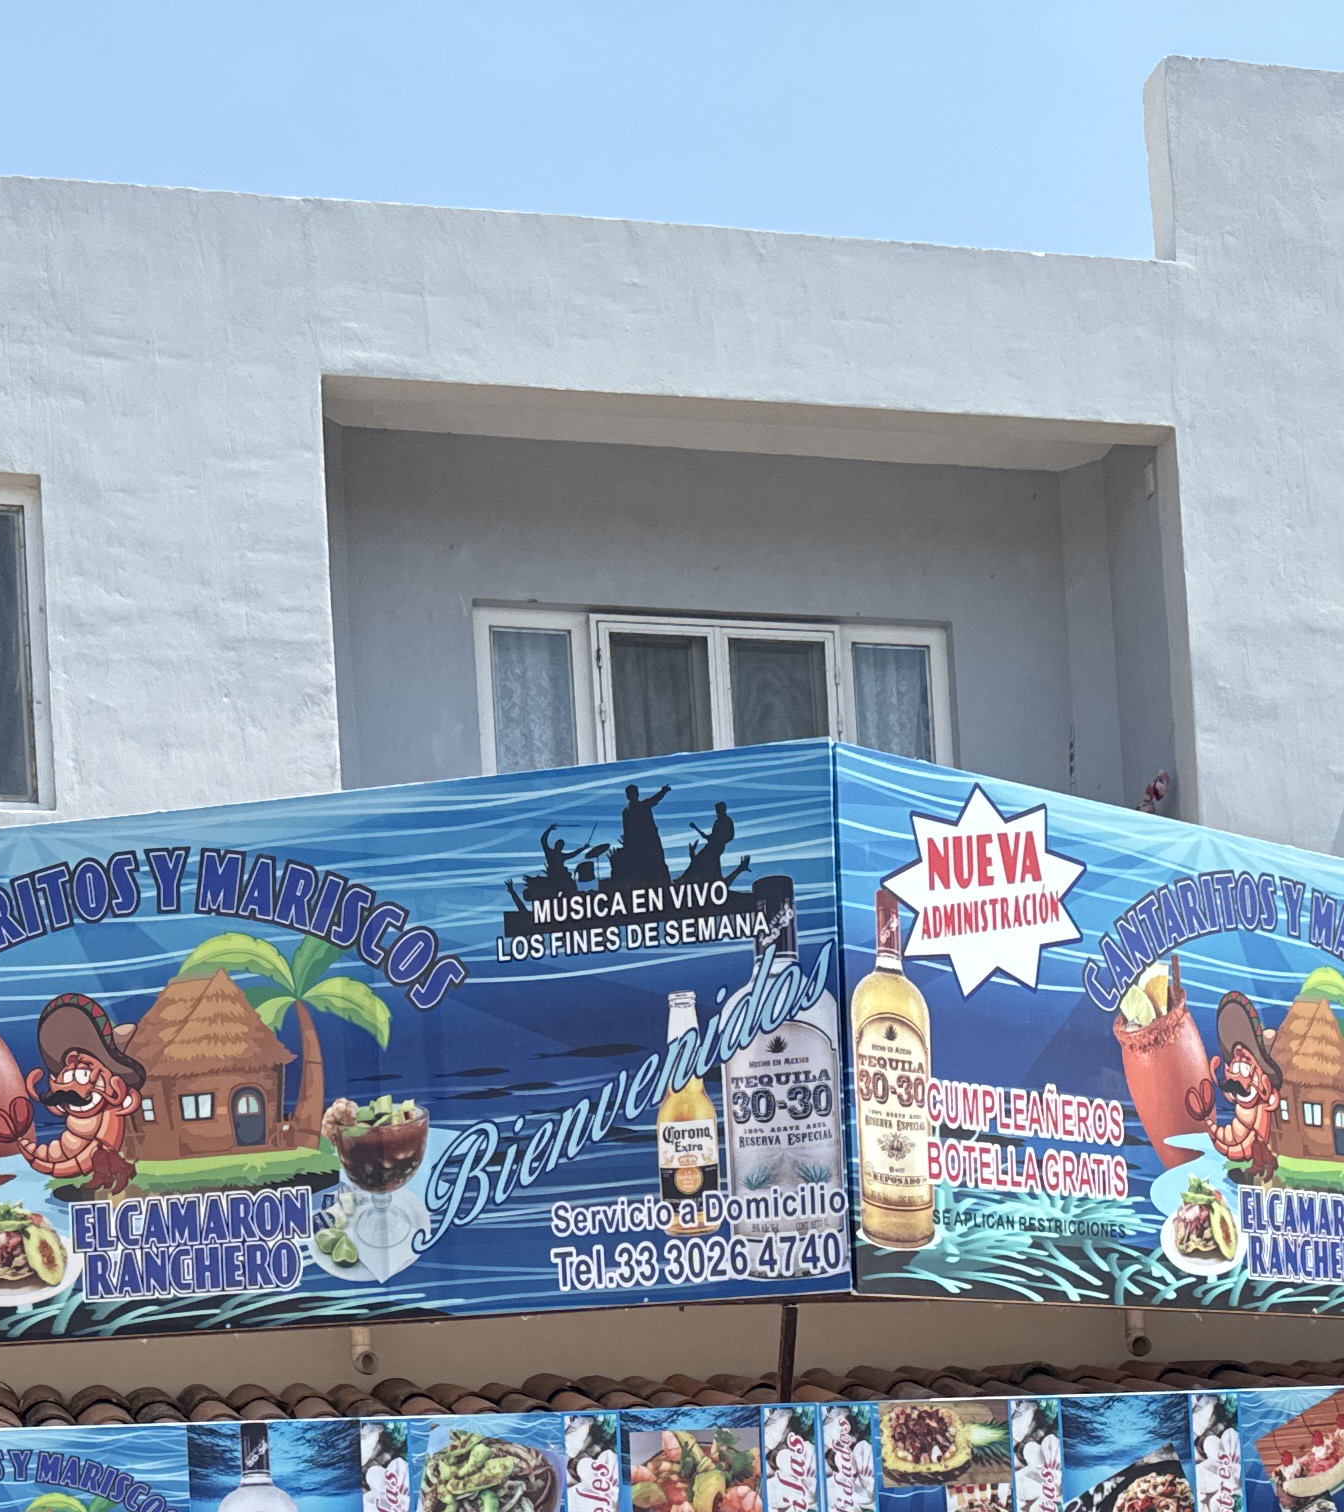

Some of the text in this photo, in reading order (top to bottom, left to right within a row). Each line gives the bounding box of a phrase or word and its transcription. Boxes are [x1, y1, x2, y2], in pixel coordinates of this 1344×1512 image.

[927, 831, 1042, 890] NUEVA
[533, 880, 728, 924] MÚSICA EN VIVO
[921, 885, 1060, 940] ADMINISTRACIÓN
[147, 849, 188, 912] Y
[198, 851, 467, 1009] MARISCOS
[497, 911, 770, 962] LOS FINES DE SEMANA
[1084, 872, 1276, 1011] CANTARITOS
[1281, 876, 1305, 937] Y
[731, 1069, 831, 1089] TEQUILA
[858, 1053, 925, 1074] TEQUILA
[859, 1070, 925, 1108] 30-30
[414, 940, 836, 1252] Bienvenidos
[732, 1082, 833, 1124] 30-30
[928, 1082, 1124, 1144] CUMPLEAÑEROS
[663, 1126, 713, 1144] Corona
[927, 1142, 1127, 1198] BOTELLA GRATIS
[72, 1189, 311, 1252] EL CAMARON
[553, 1185, 847, 1238] Servicio a Domicilio
[933, 1209, 1126, 1239] SE APLICAN RESTRICCIONES
[1241, 1190, 1267, 1233] EL
[85, 1240, 301, 1301] RANCHERO
[670, 1238, 750, 1285] 3026
[759, 1232, 841, 1275] 4740
[9, 1450, 32, 1480] Y
